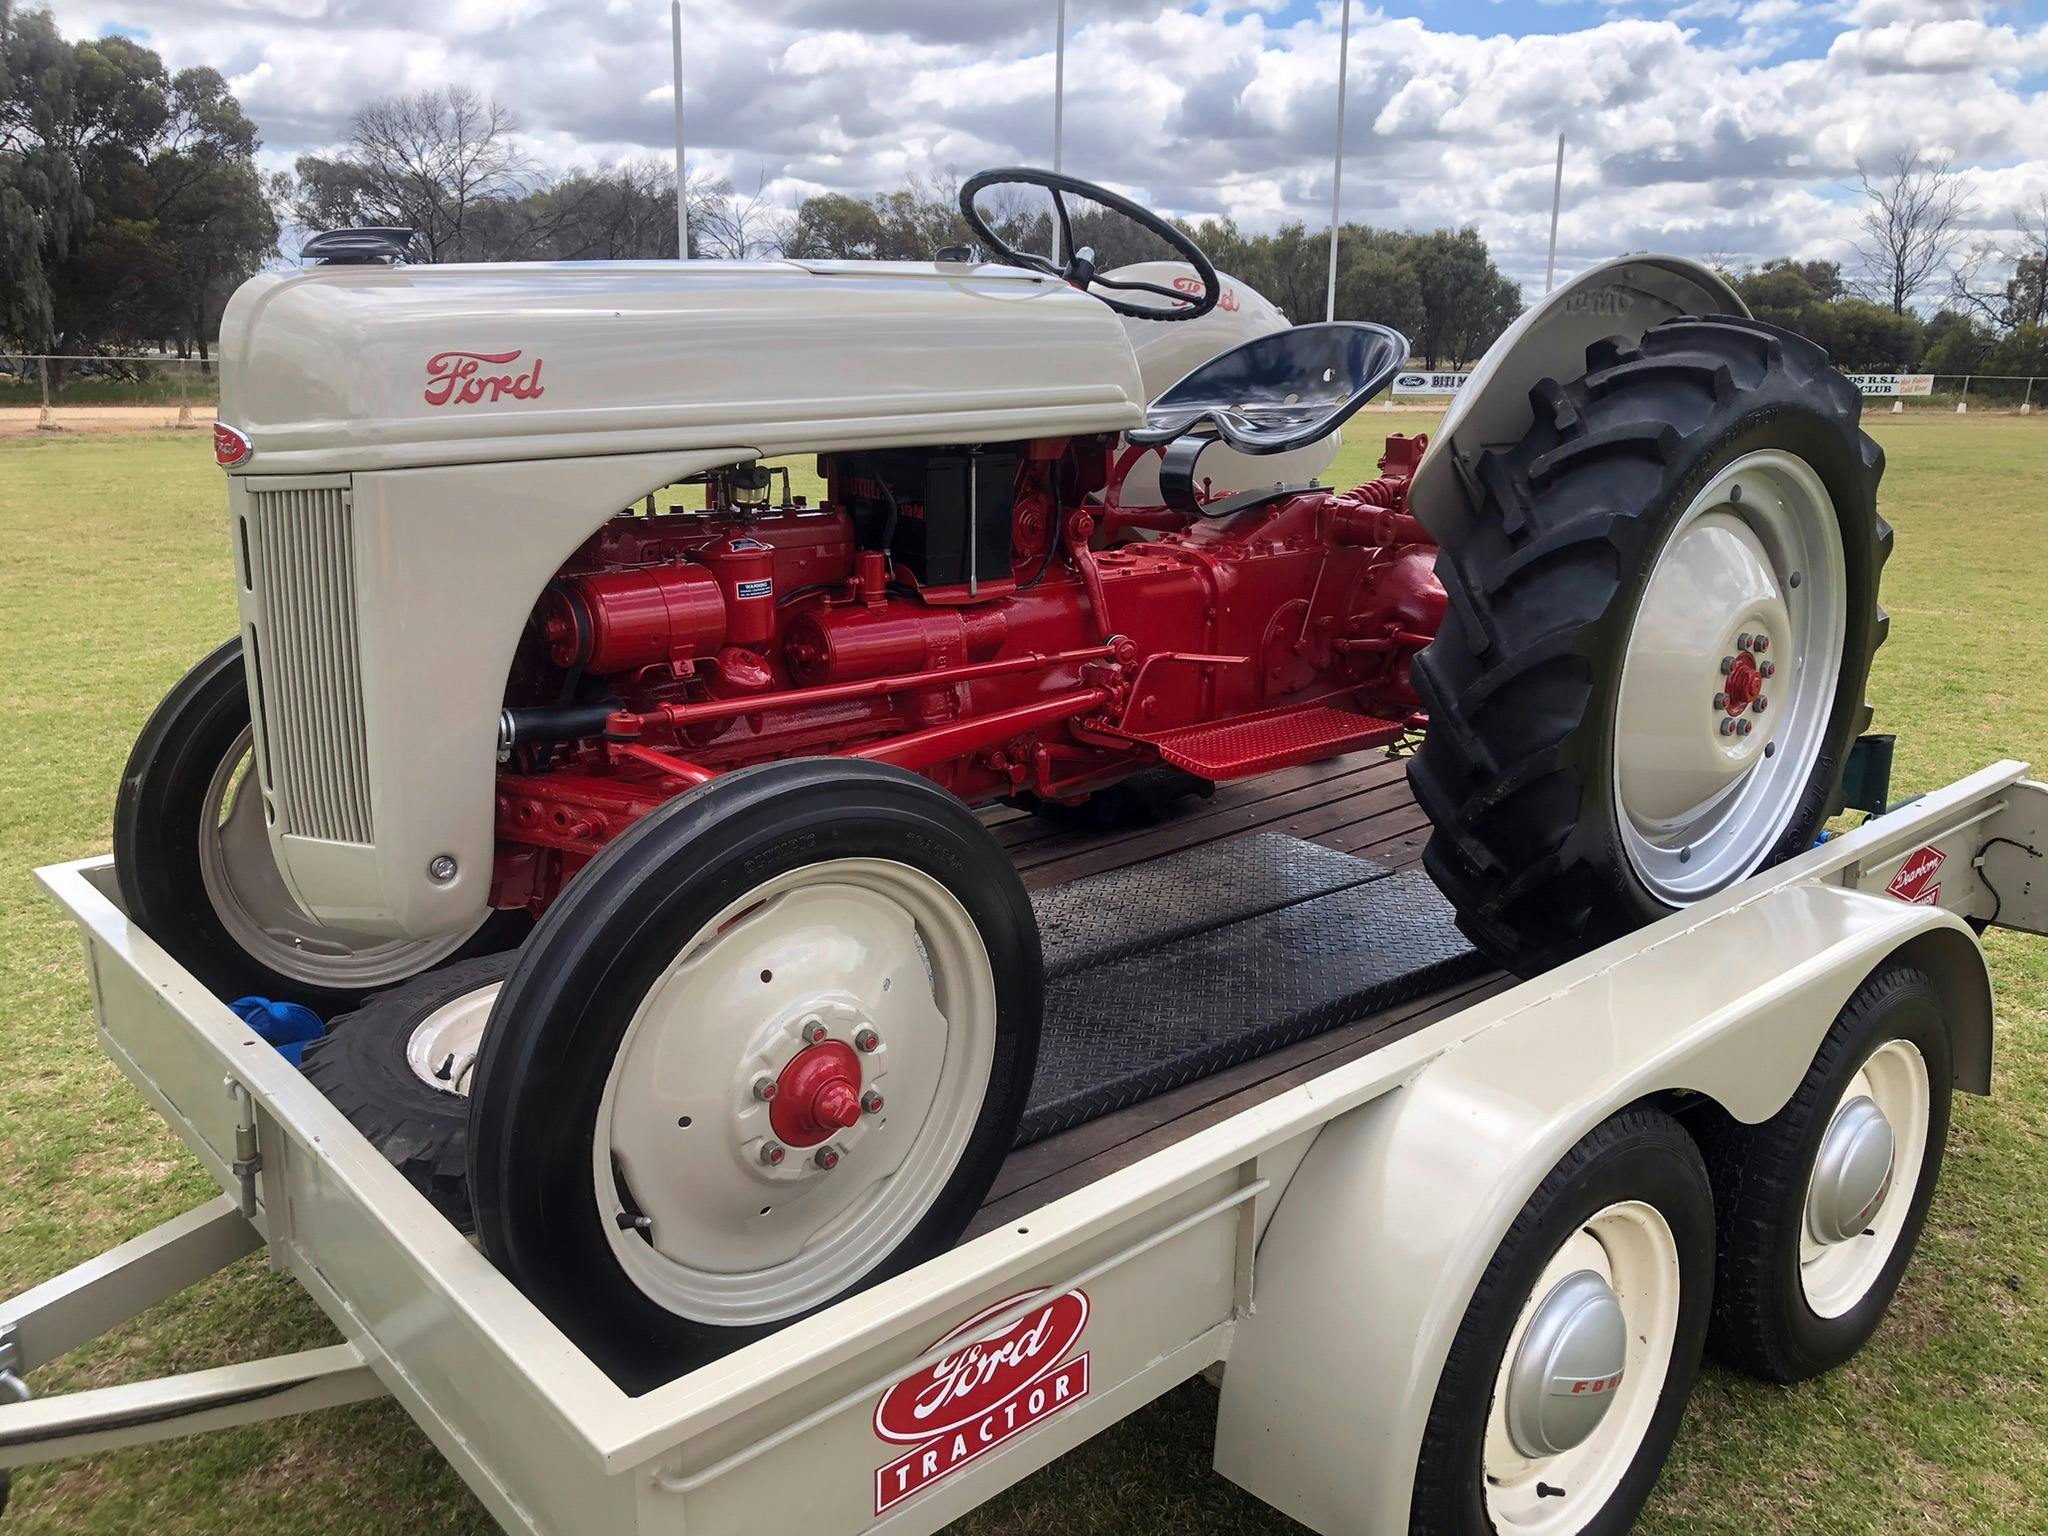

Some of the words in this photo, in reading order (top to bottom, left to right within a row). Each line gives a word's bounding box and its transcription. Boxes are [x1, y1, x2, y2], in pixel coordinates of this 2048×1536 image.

[424, 349, 545, 406] Ford
[1432, 376, 1455, 387] BITI
[1860, 385, 1892, 393] CLUB
[1867, 376, 1900, 384] R.S.L.
[1895, 855, 1939, 890] Dearborn
[913, 1306, 1054, 1420] Ford
[895, 1374, 1070, 1491] TRACTOR
